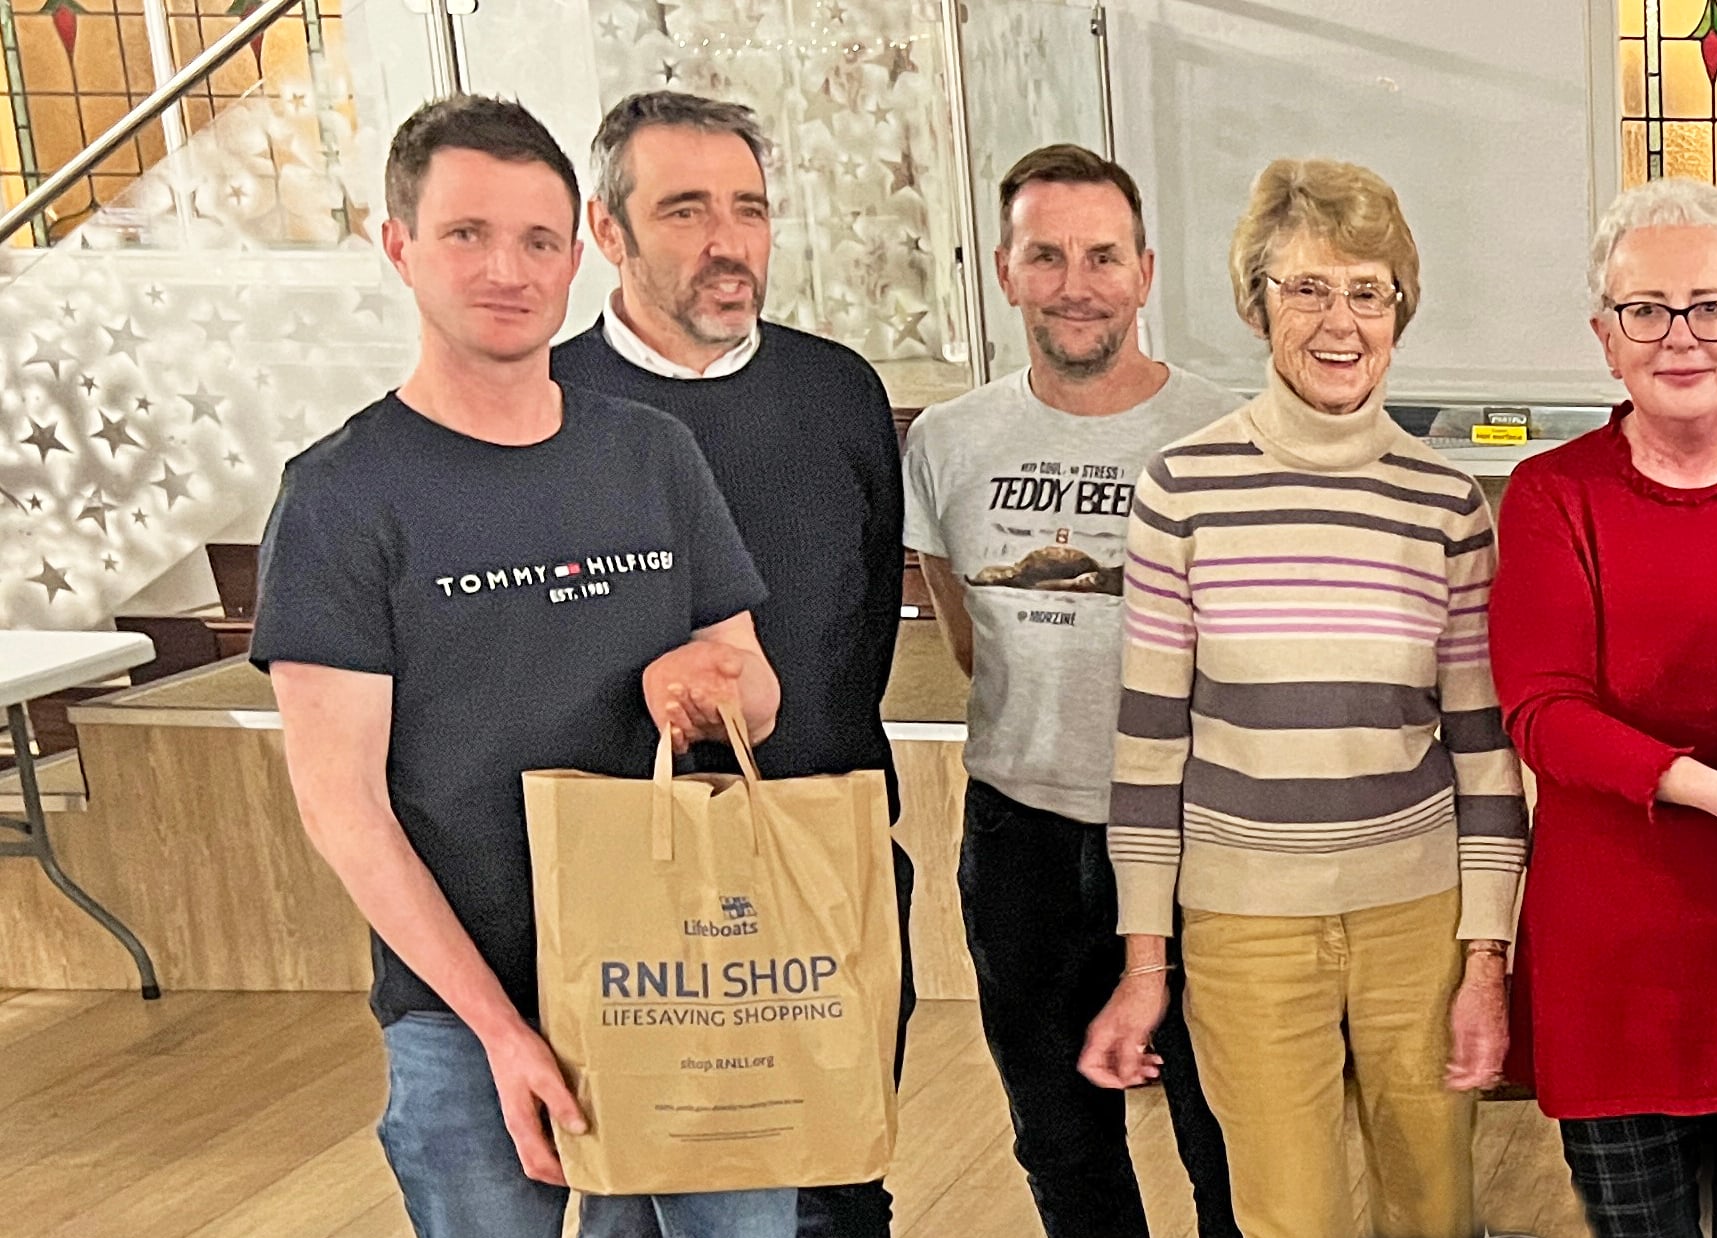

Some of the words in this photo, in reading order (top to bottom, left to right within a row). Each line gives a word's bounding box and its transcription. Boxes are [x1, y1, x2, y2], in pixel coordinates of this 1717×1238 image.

[989, 477, 1074, 513] TEDDY
[436, 565, 547, 597] TOMMY
[550, 587, 579, 603] EST.
[684, 919, 758, 937] Lifeboats
[601, 960, 709, 998] RNLI
[722, 956, 837, 998] SHOP
[602, 1008, 725, 1027] LIFESAVING
[733, 1001, 843, 1026] SHOPPING
[680, 1056, 775, 1073] shop.RNLI.org
